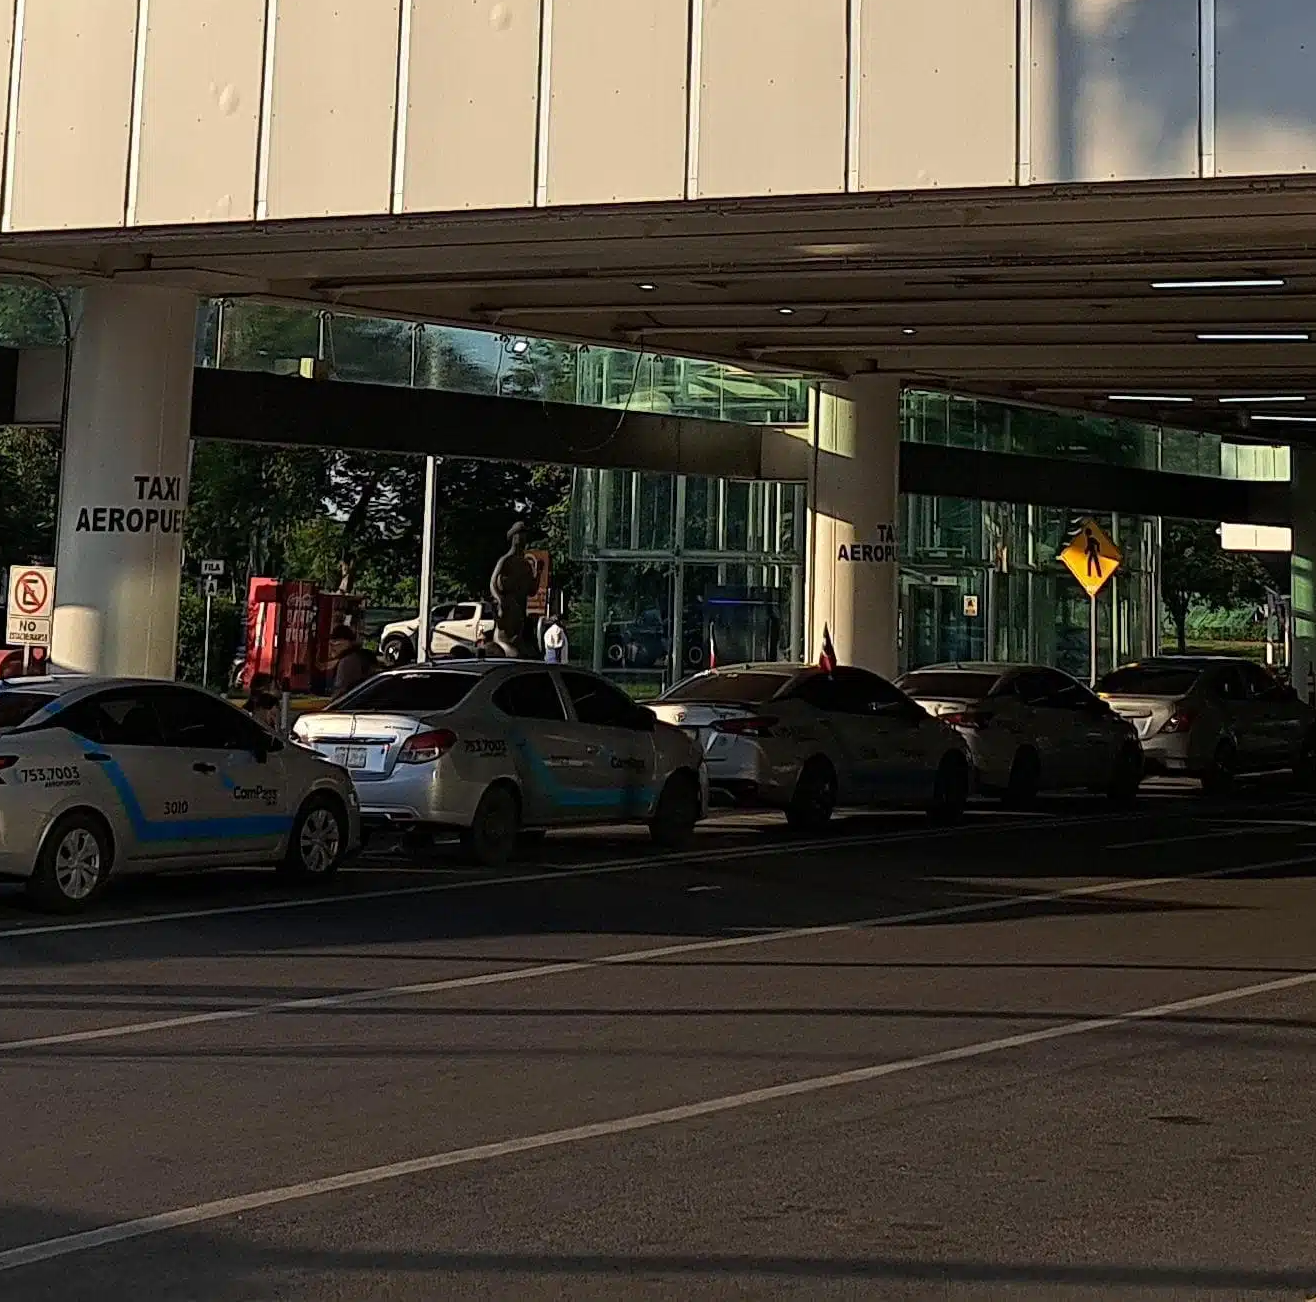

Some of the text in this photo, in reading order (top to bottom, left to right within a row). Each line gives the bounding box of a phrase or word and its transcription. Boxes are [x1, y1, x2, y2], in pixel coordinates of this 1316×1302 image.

[134, 475, 181, 501] TAXI
[75, 507, 185, 534] AEROPUE
[19, 620, 37, 632] NO
